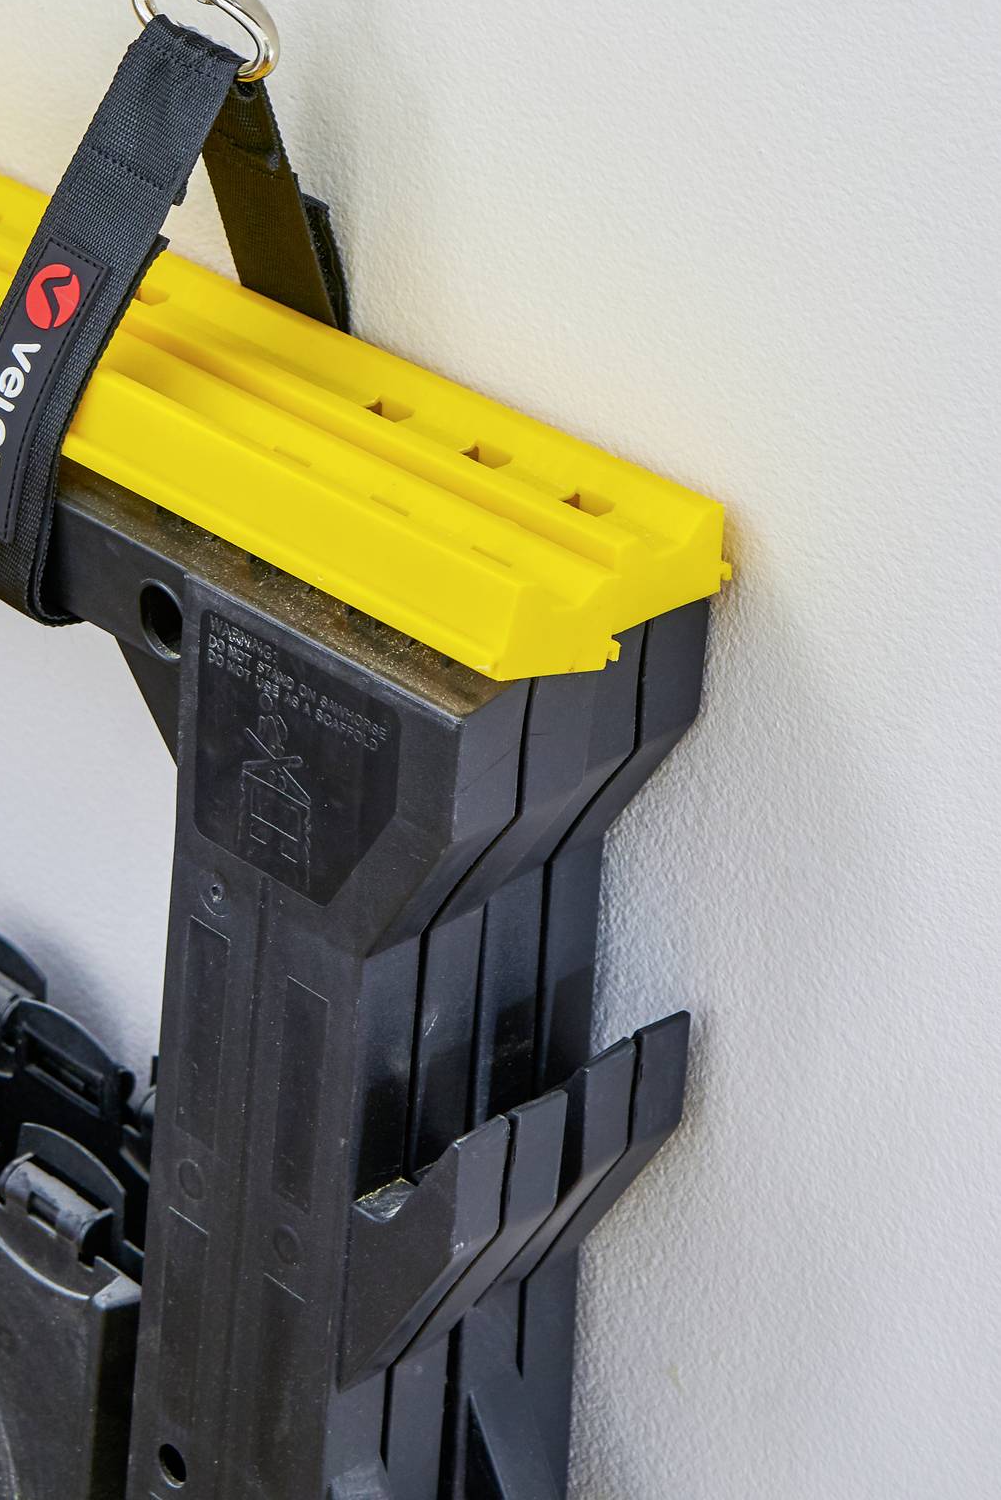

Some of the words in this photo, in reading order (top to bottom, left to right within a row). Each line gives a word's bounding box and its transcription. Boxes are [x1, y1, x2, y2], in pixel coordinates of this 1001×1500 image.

[207, 648, 225, 668] DO
[226, 659, 252, 682] NOT
[254, 675, 279, 699] USE
[208, 633, 226, 653] DO
[227, 644, 253, 666] NOT
[256, 660, 296, 691] STAND
[298, 683, 317, 703] ON
